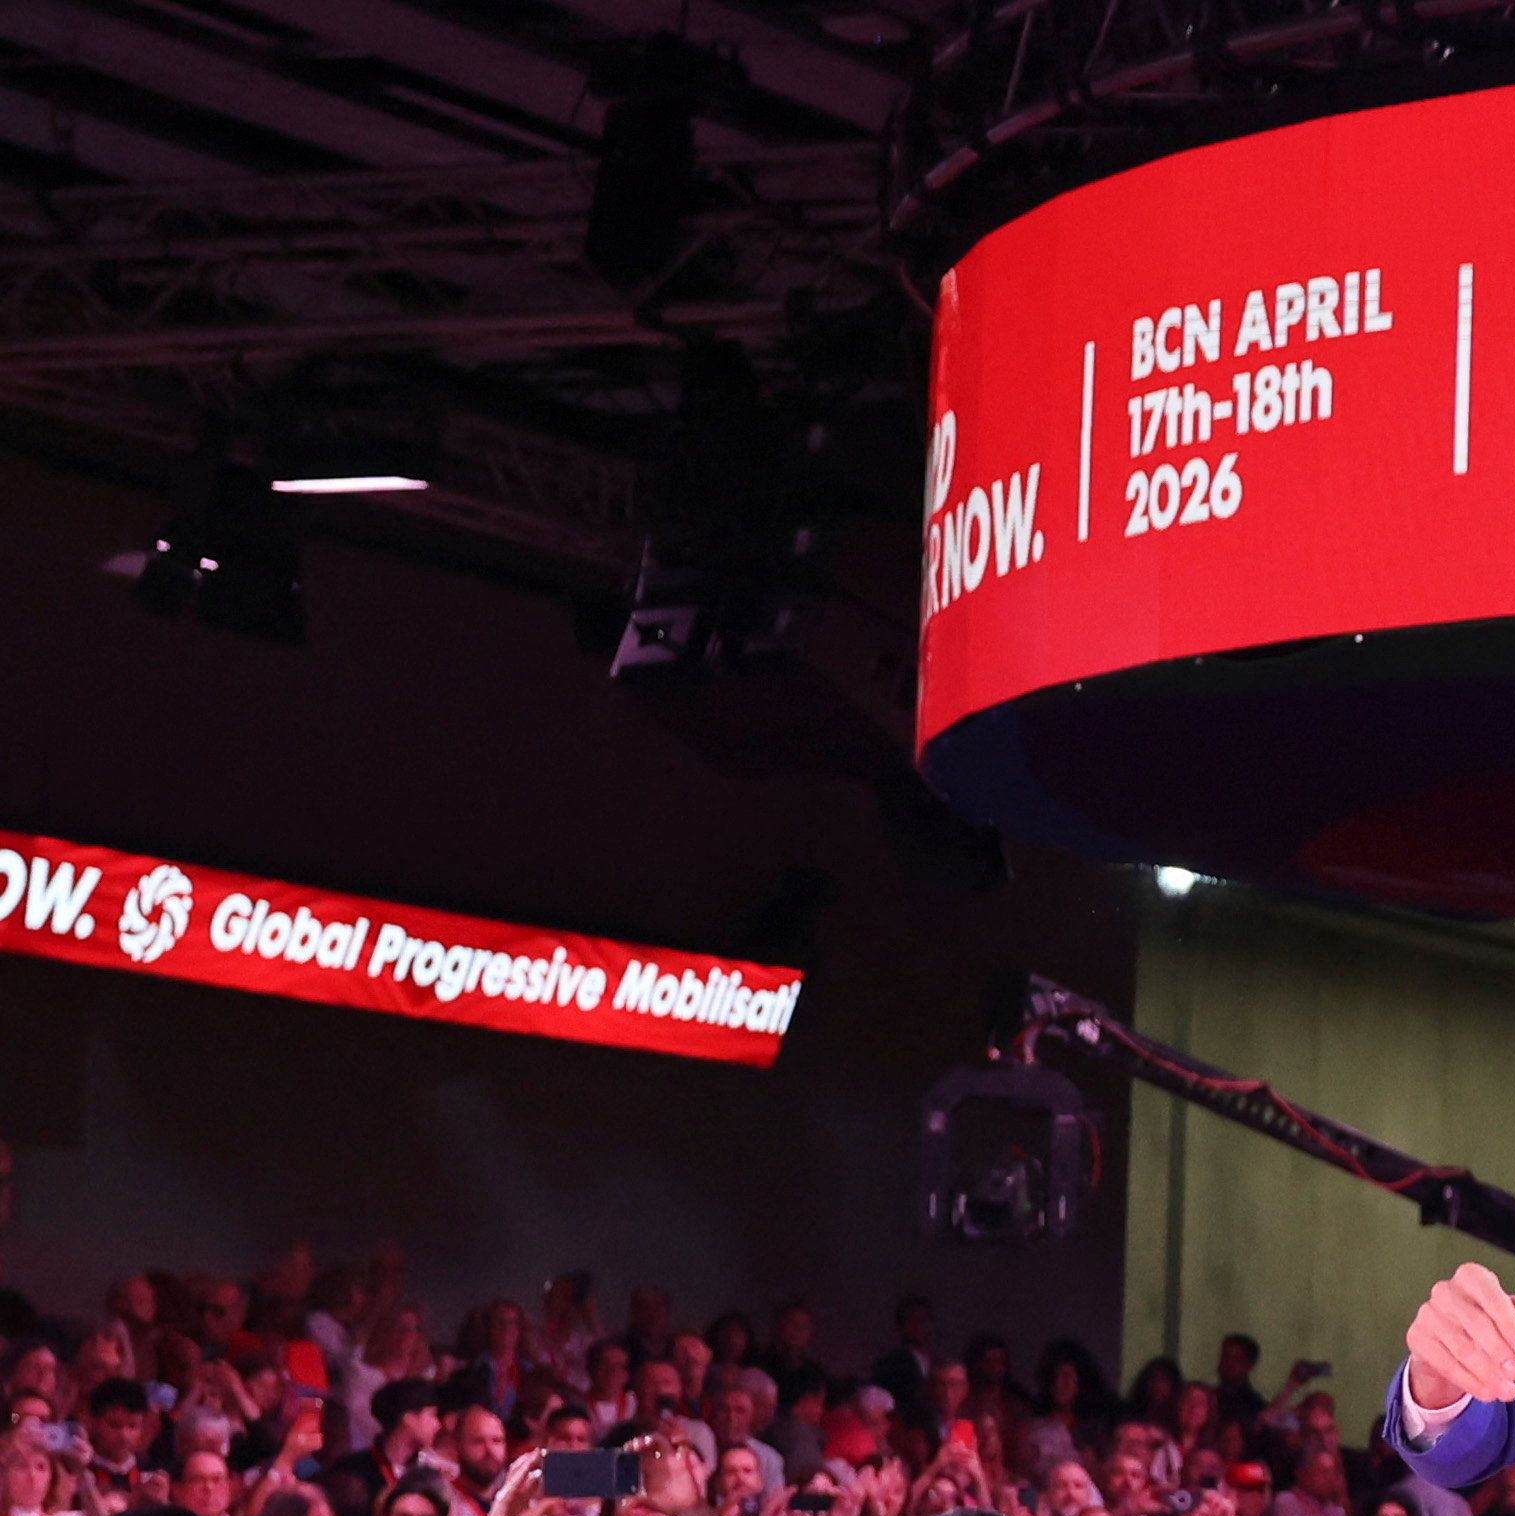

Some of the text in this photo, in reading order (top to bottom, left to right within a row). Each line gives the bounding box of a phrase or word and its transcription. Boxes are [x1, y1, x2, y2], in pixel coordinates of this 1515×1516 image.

[1131, 268, 1393, 381] BCN APRIL
[1127, 359, 1333, 458] 17th-18th
[941, 462, 1044, 610] NOW.
[1125, 452, 1243, 538] 2026
[211, 893, 370, 971] Global
[368, 924, 607, 1012] Progressive
